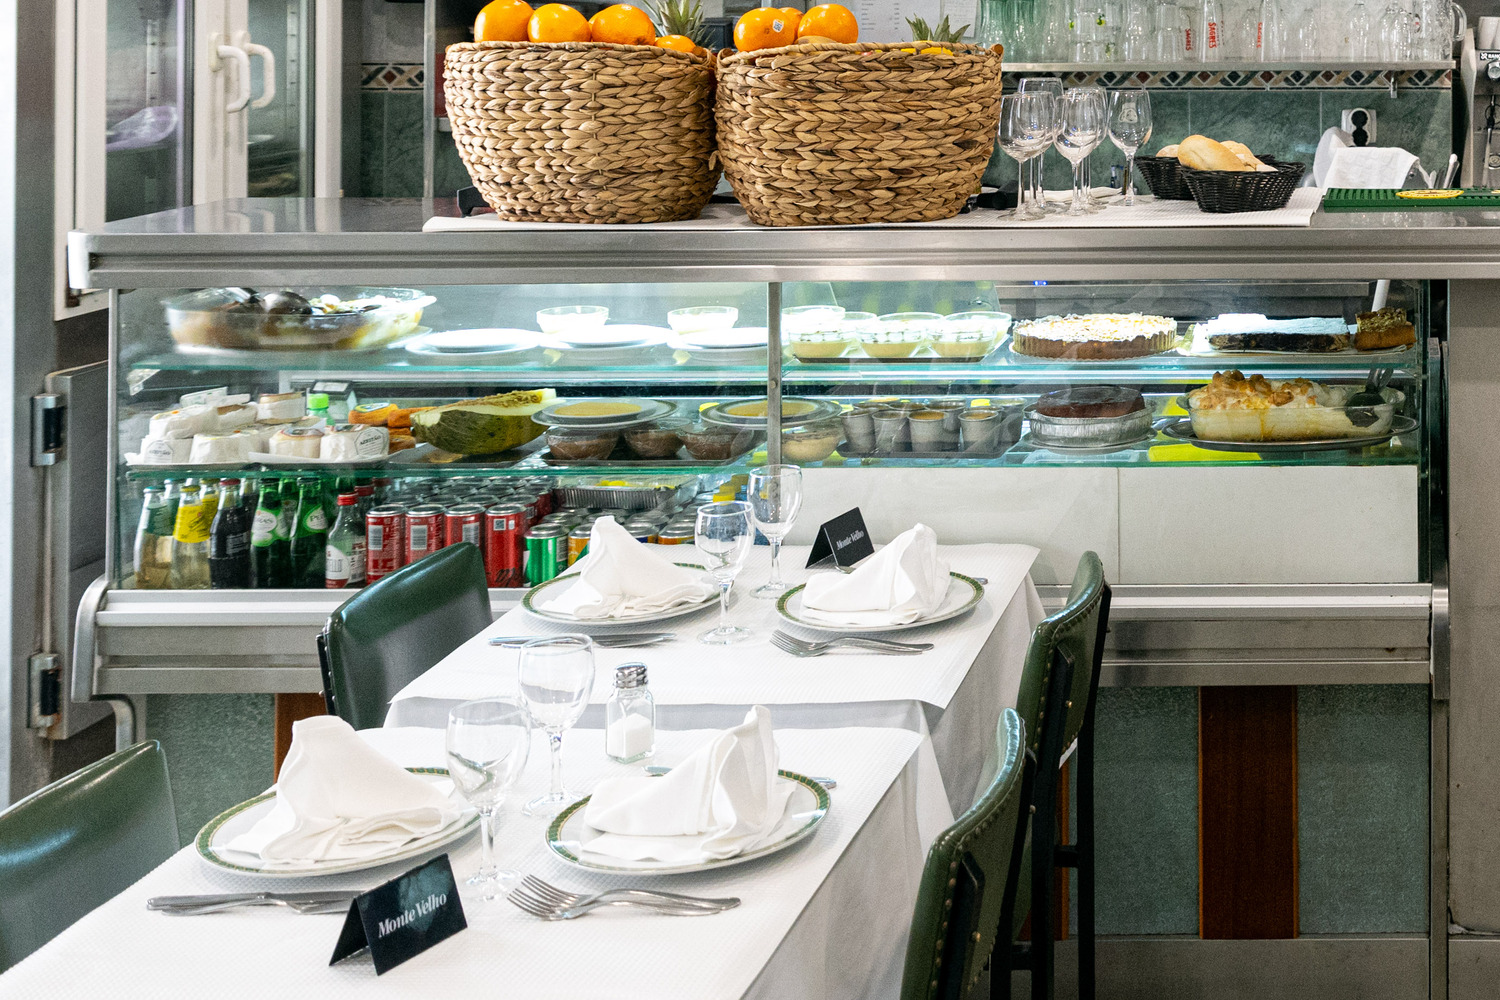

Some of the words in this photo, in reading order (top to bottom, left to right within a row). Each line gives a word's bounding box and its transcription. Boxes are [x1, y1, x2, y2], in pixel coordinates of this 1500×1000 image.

[1208, 22, 1217, 49] SAGRES
[836, 536, 852, 550] Monte
[850, 529, 865, 542] Velho
[378, 909, 416, 939] Monte
[415, 893, 447, 918] Velho
